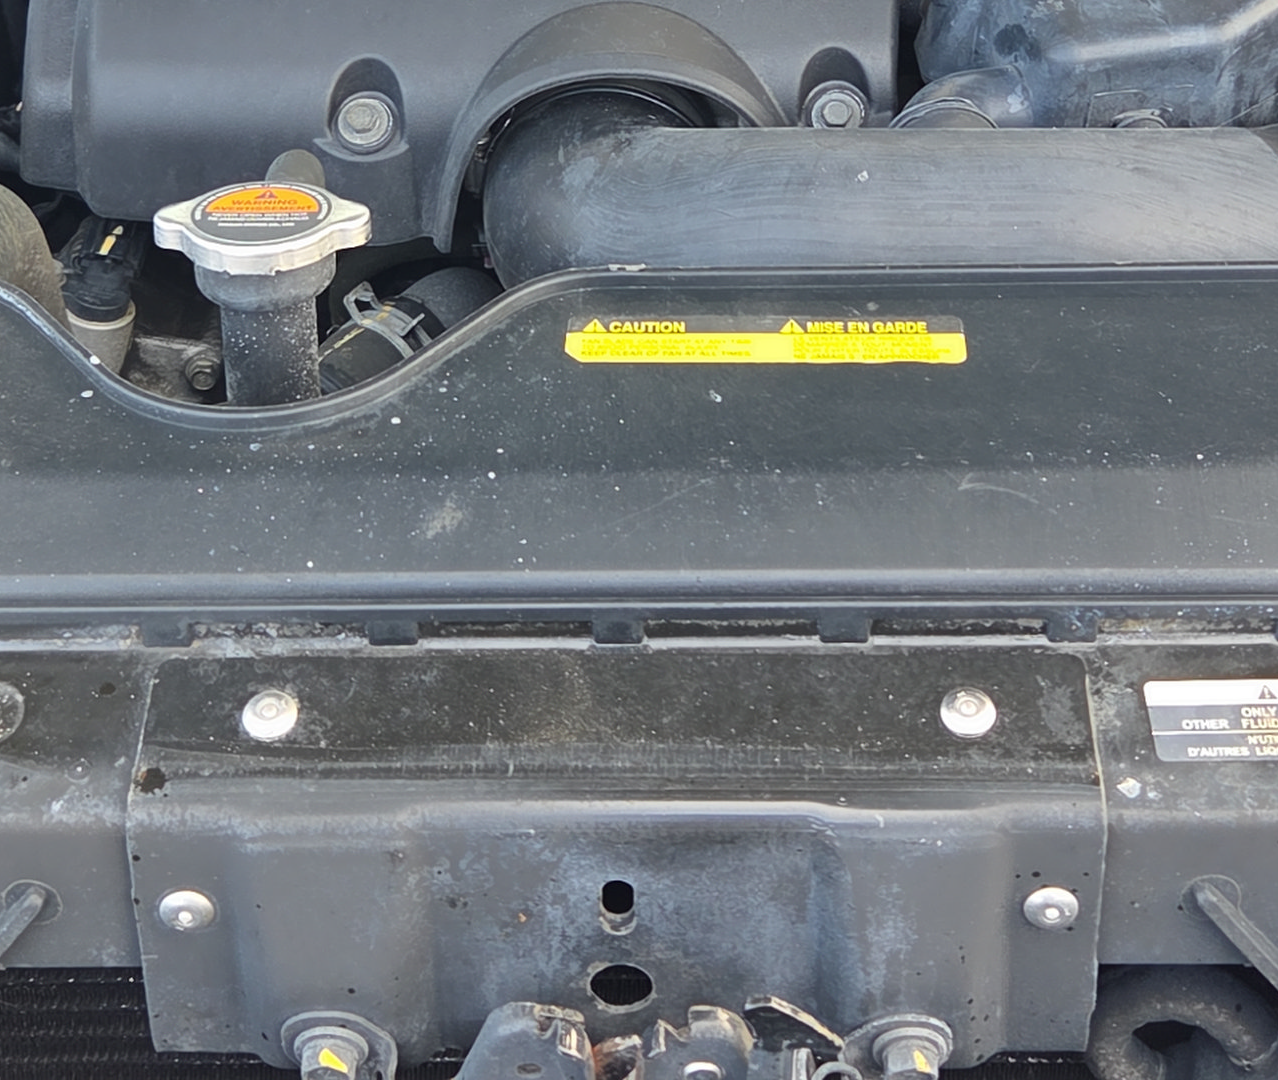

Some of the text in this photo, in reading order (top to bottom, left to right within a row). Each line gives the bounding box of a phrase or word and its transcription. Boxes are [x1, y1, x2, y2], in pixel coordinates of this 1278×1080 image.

[608, 320, 686, 333] CAUTION
[806, 320, 928, 333] MISE EN GARDE
[1240, 706, 1277, 718] ONLY
[1181, 719, 1230, 730] OTHER
[1187, 746, 1250, 758] D'AUTRES
